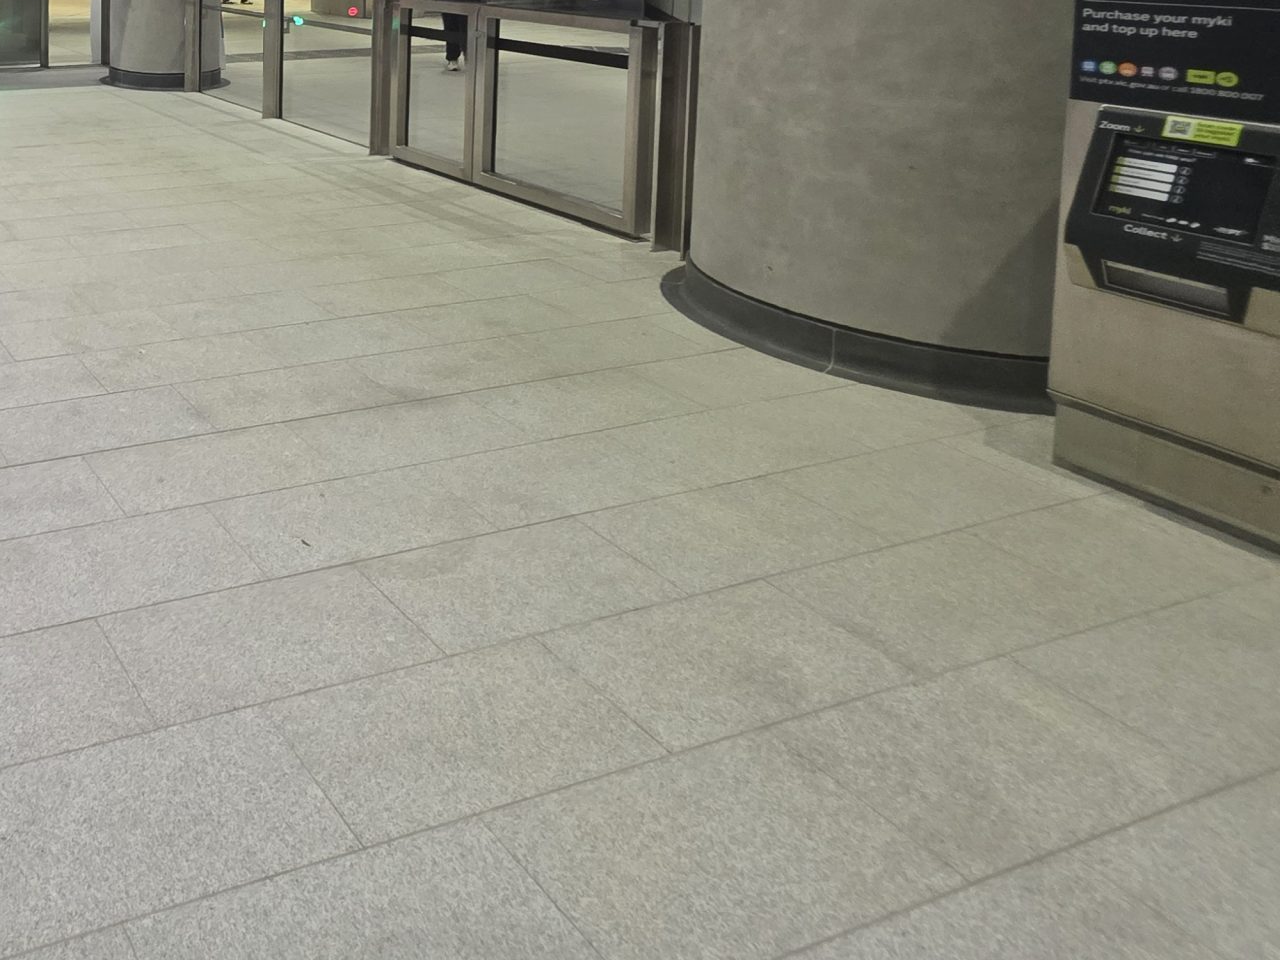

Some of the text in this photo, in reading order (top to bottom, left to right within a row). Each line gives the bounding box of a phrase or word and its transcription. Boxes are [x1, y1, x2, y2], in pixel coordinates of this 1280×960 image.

[1082, 8, 1233, 28] Purchase your myki
[1081, 23, 1198, 39] and top up here
[1099, 120, 1131, 132] Zoom
[1123, 224, 1167, 240] Collect
